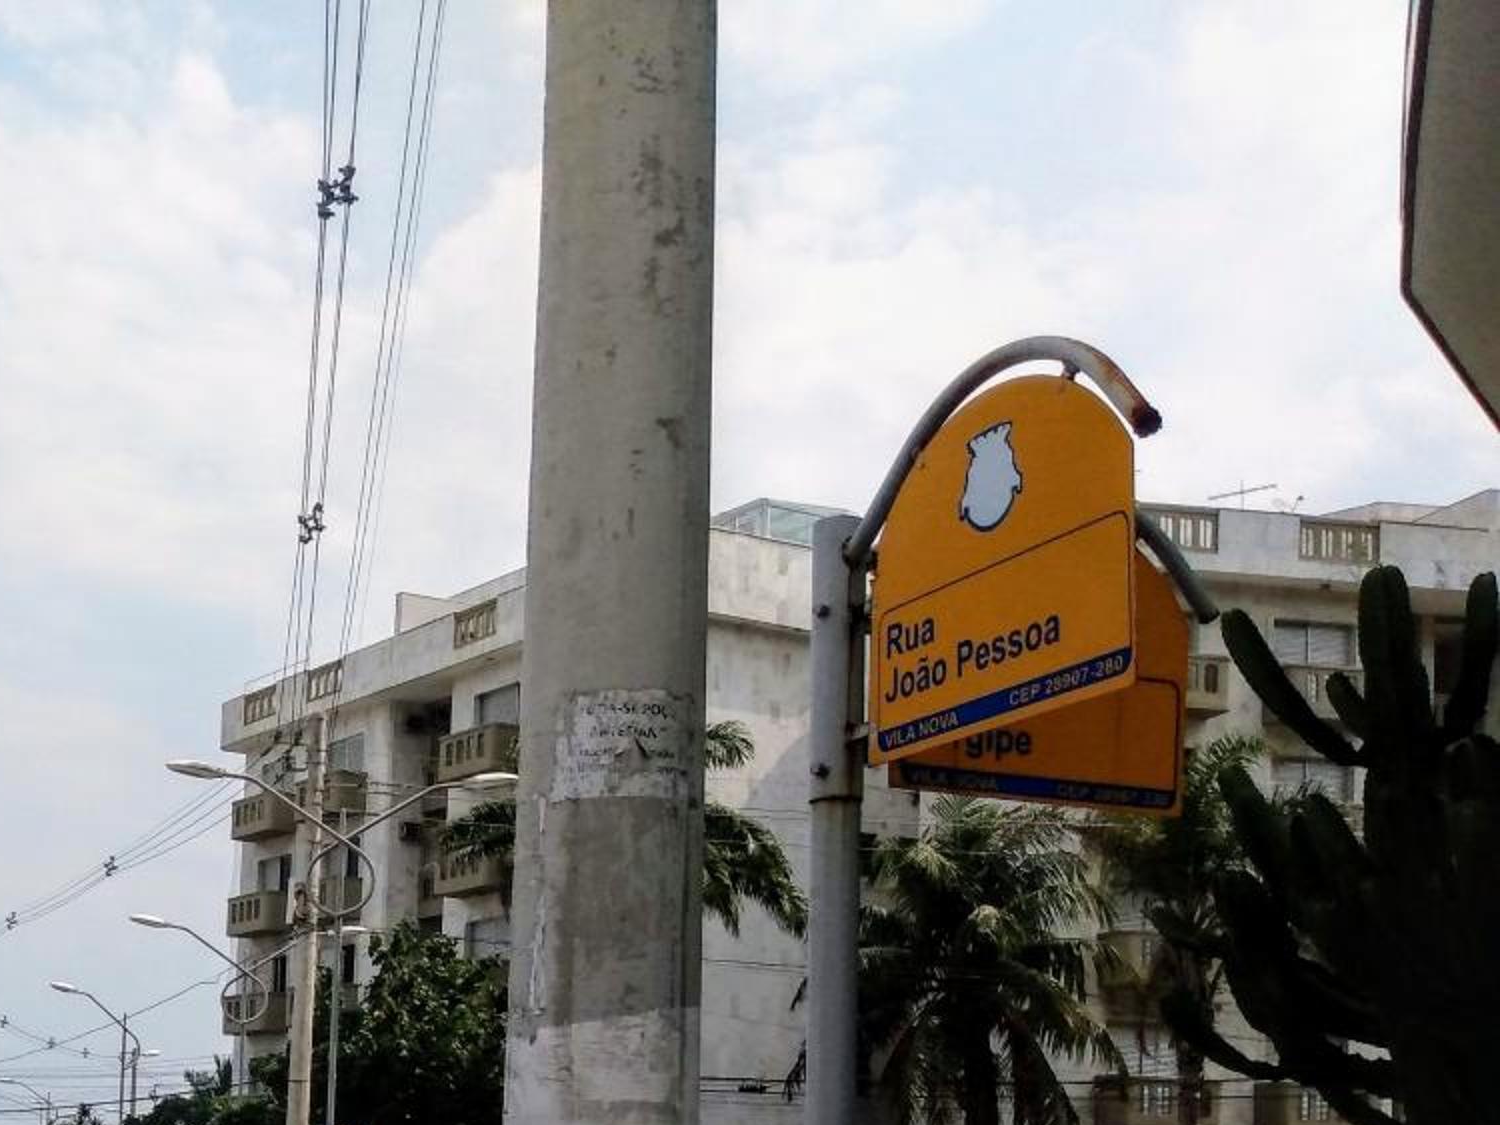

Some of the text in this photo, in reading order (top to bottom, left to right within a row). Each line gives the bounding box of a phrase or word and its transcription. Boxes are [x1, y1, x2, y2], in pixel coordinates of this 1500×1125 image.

[887, 617, 935, 660] Rua
[885, 614, 1061, 704] João Pessoa
[1009, 682, 1041, 706] CEP
[884, 711, 959, 748] VILA NOVA
